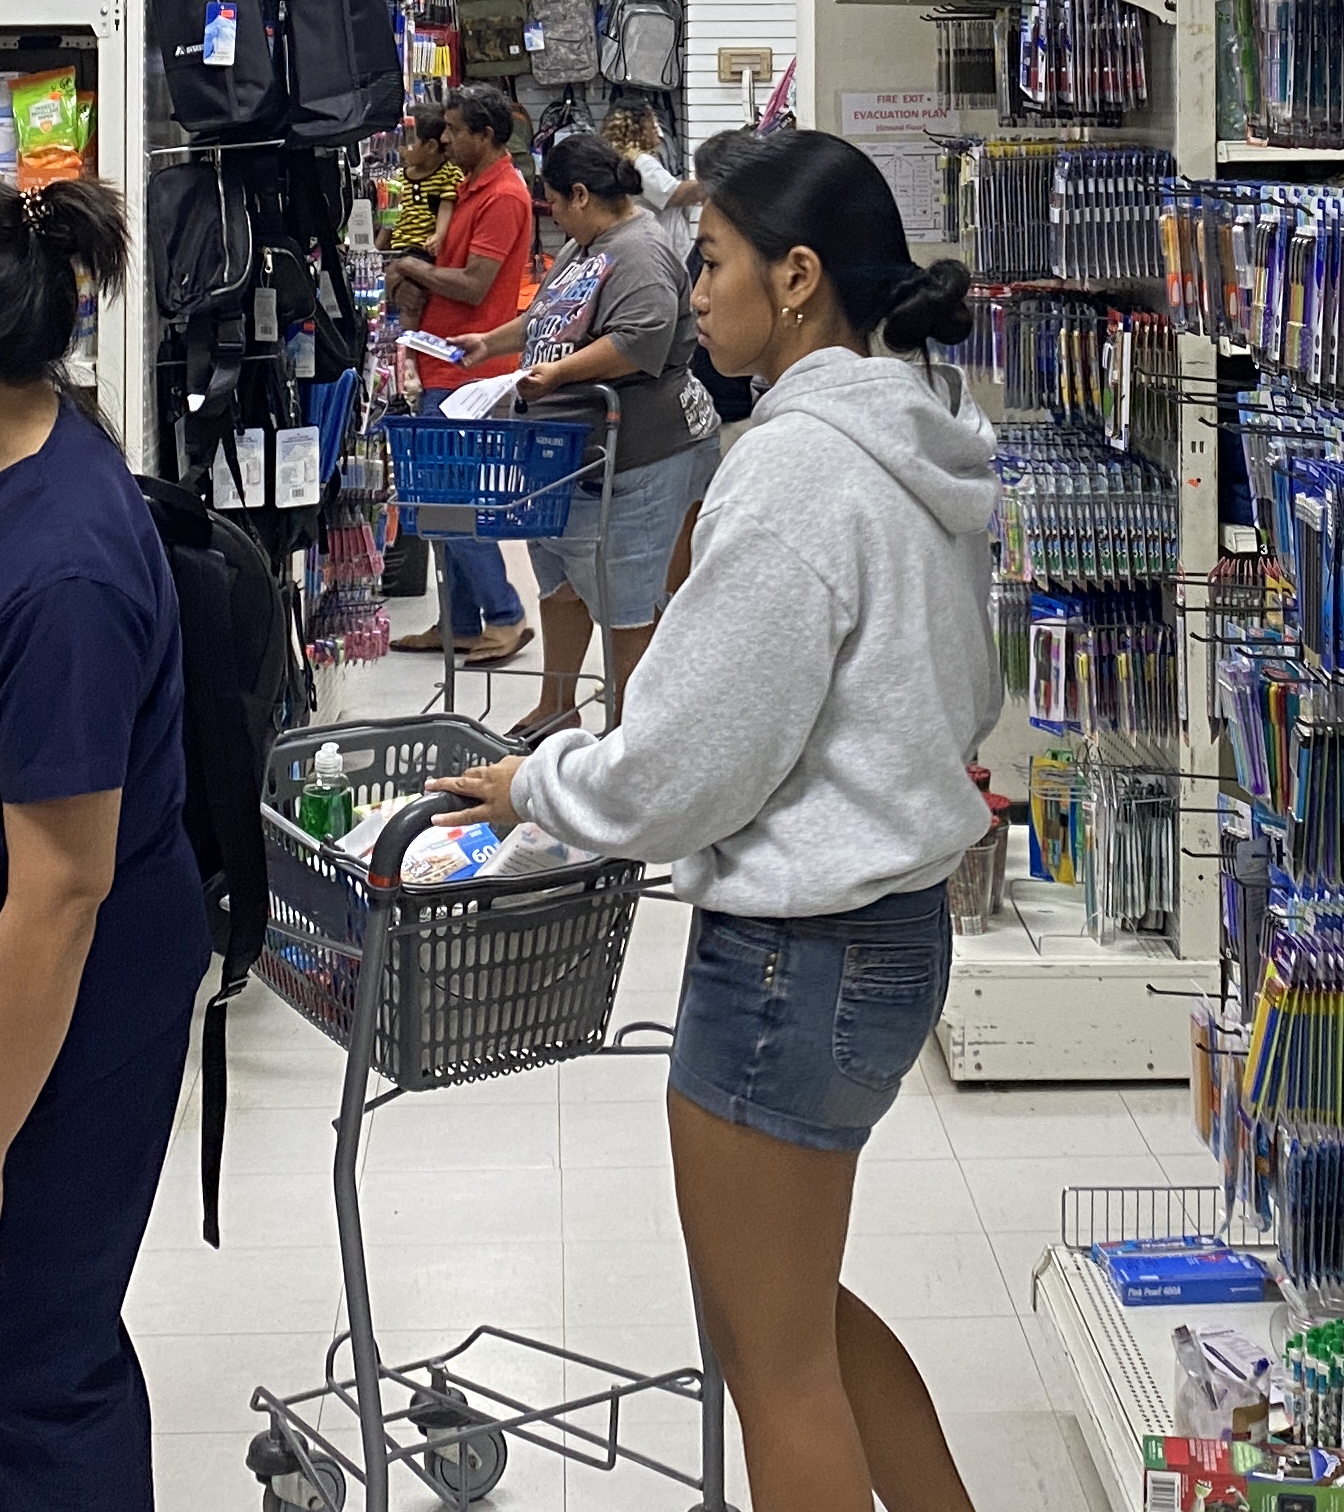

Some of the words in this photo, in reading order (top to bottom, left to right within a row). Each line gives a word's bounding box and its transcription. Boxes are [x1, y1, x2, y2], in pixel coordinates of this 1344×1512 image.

[877, 95, 898, 104] FIRE
[903, 94, 924, 103] EXIT
[854, 109, 919, 120] EVACUATION
[922, 109, 948, 118] PLAN
